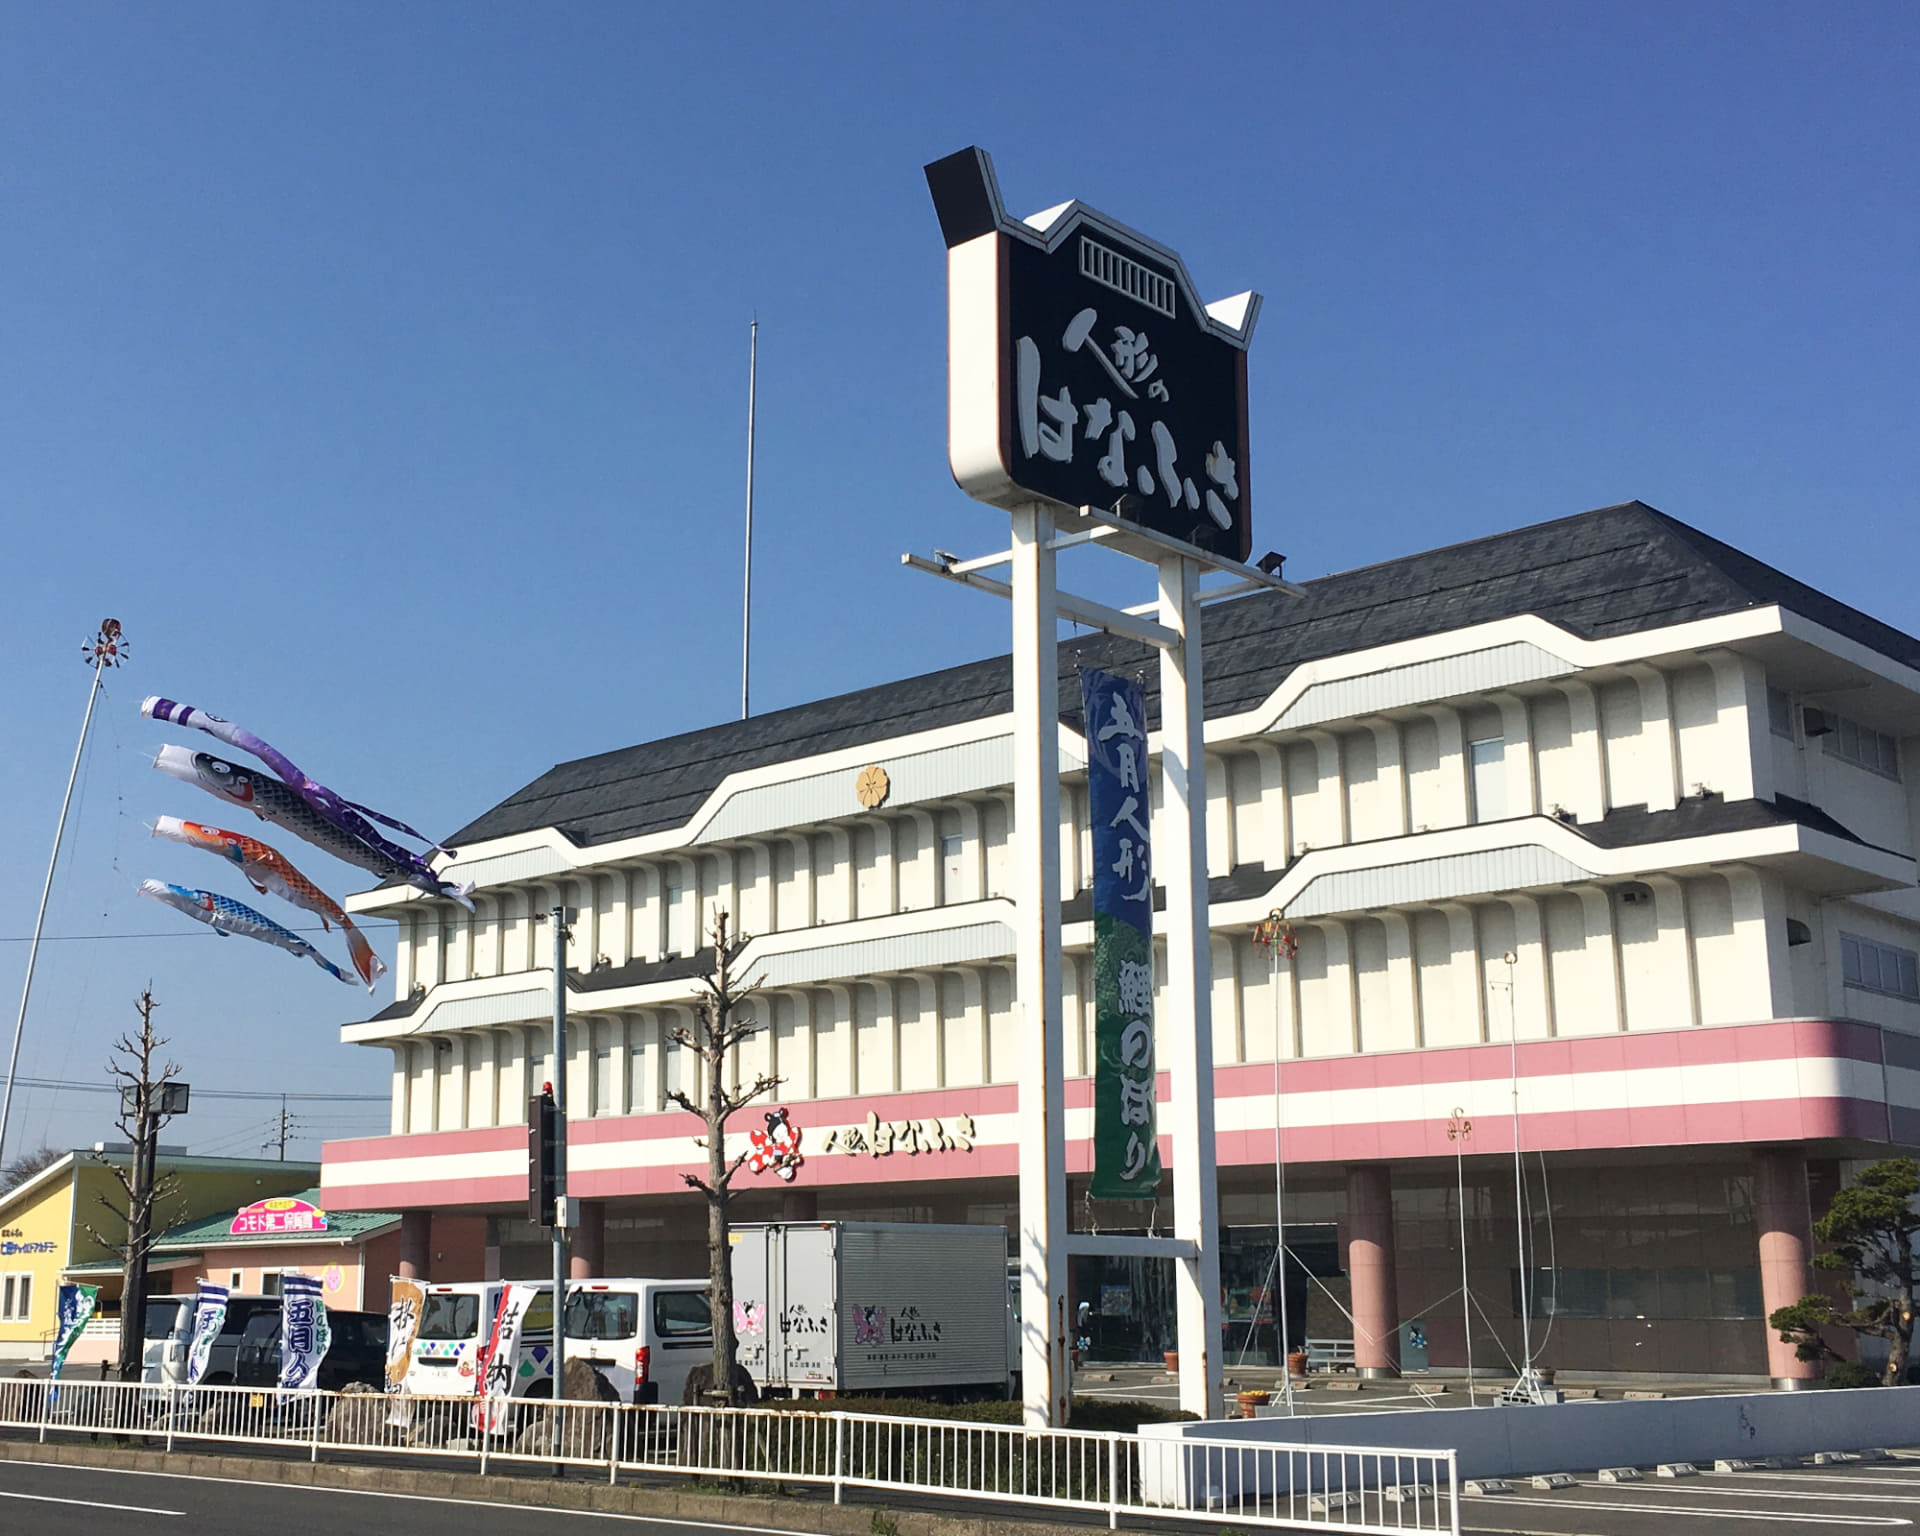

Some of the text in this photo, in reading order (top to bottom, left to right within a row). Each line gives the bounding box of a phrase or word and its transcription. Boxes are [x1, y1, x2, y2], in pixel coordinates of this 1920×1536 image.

[1062, 307, 1169, 402] 人形の
[1016, 335, 1239, 530] はなふさ
[1098, 691, 1151, 903] 五月人形
[1116, 960, 1154, 1181] 鯉のぼり
[867, 1110, 976, 1157] はなふさ
[485, 1301, 520, 1396] 結納
[780, 1312, 828, 1334] はなふさ
[890, 1317, 942, 1344] はなふさ
